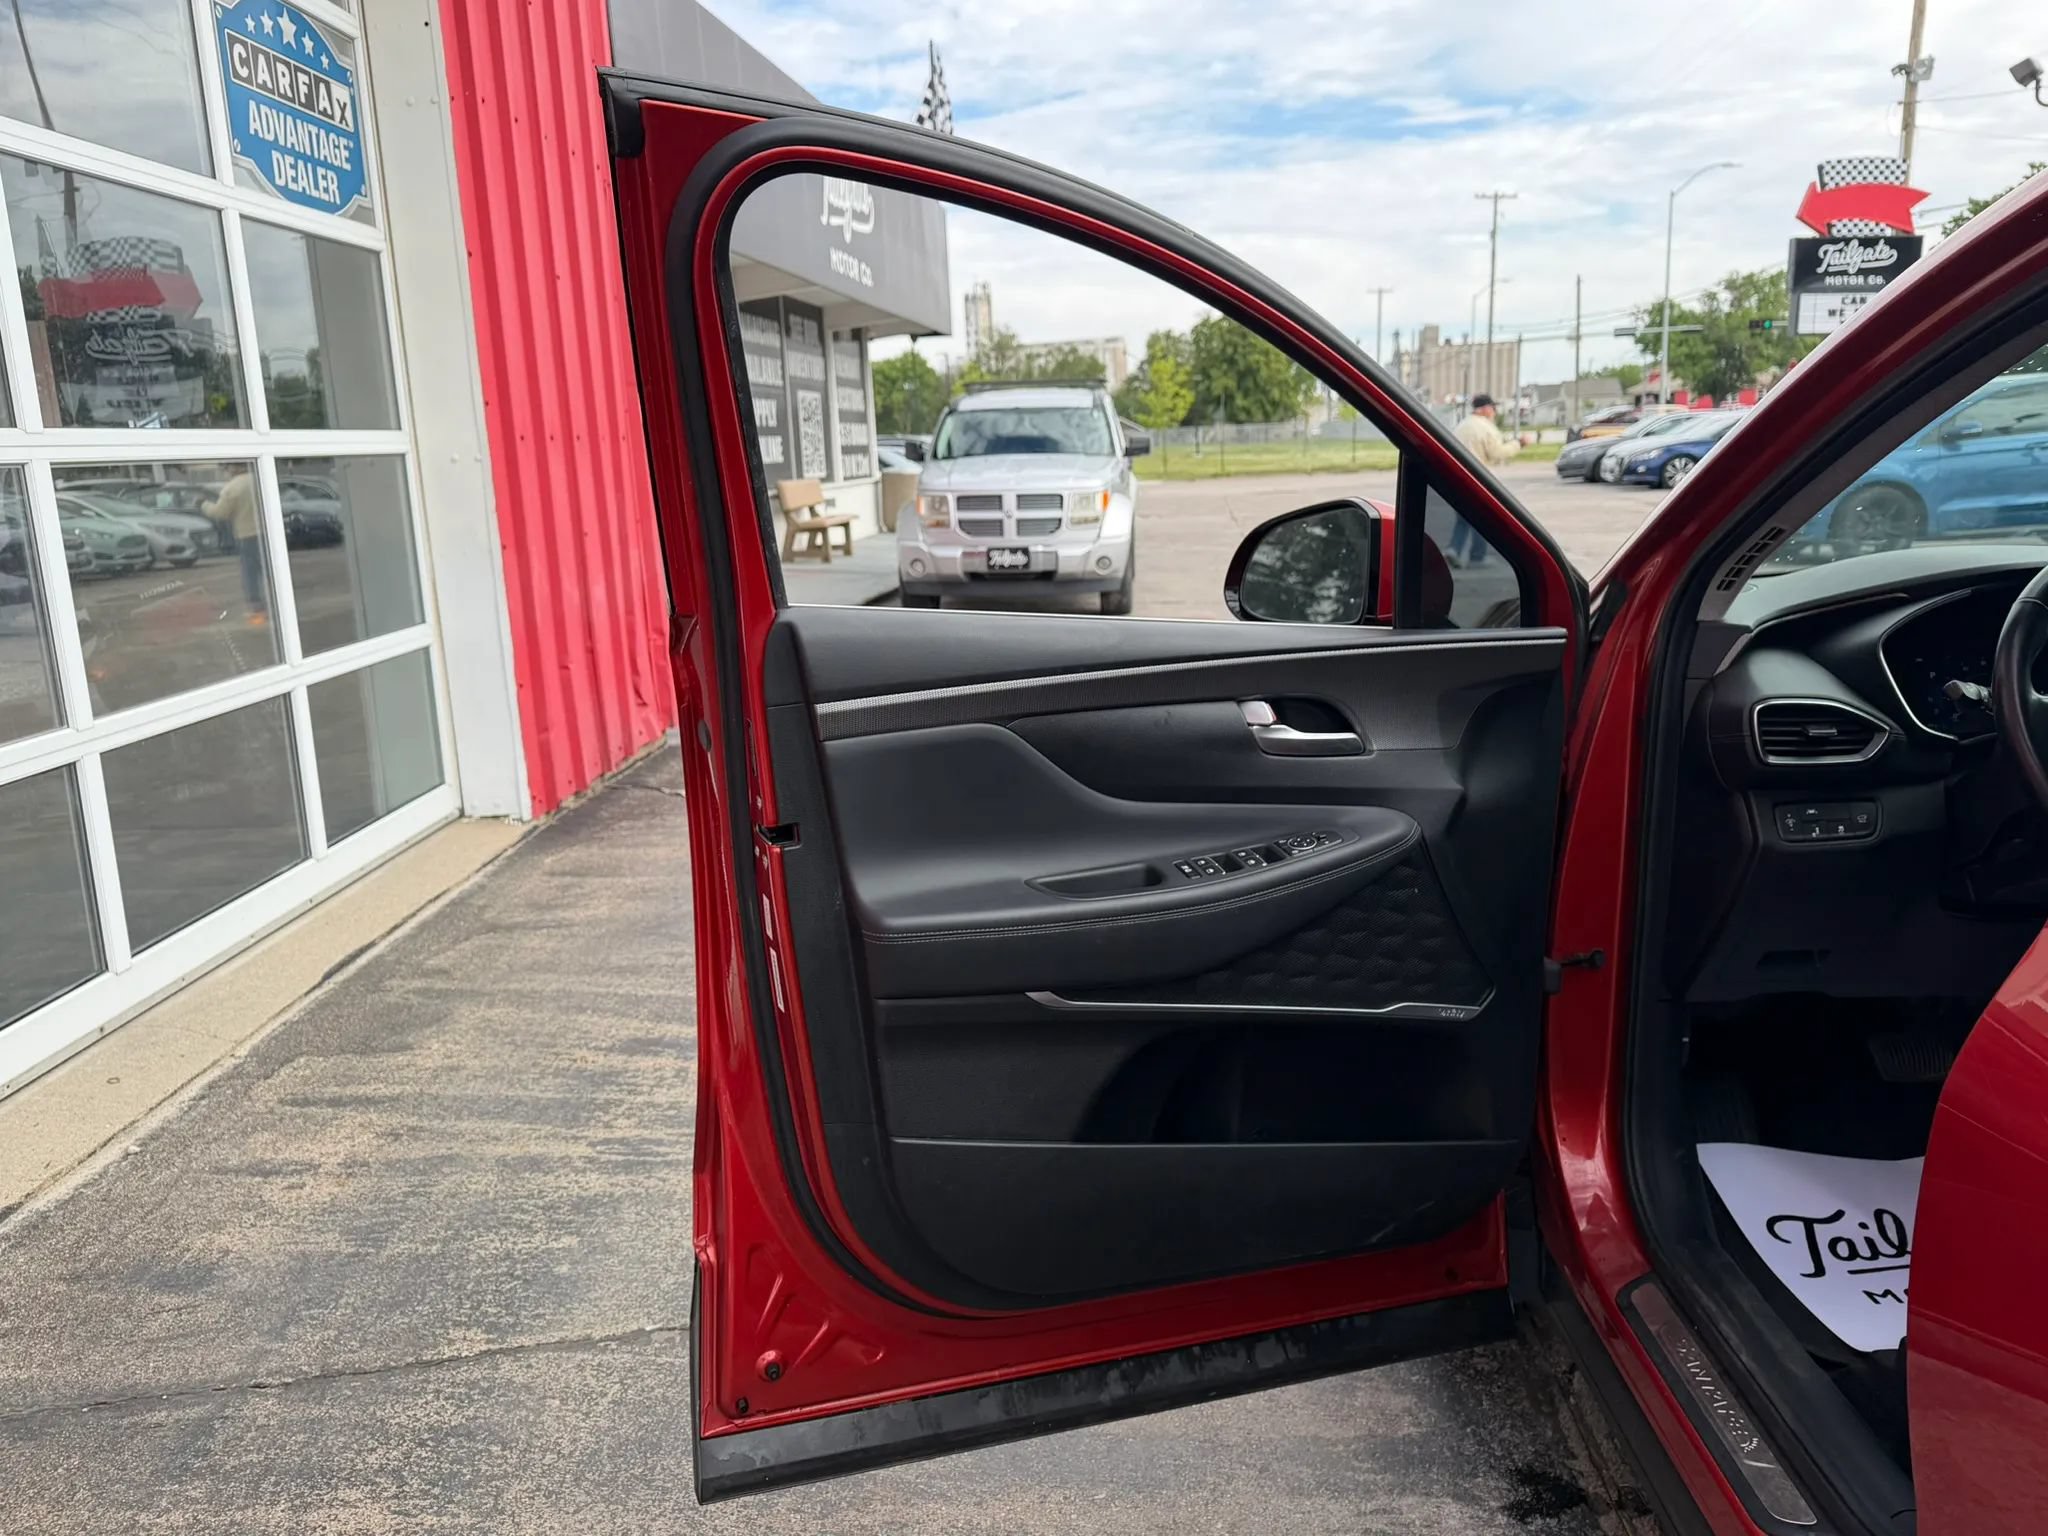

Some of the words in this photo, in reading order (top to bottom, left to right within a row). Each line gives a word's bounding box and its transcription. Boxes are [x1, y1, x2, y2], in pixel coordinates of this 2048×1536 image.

[231, 42, 350, 128] CARFAX
[249, 99, 351, 172] ADVANTAGE
[271, 149, 340, 205] DEALER
[1815, 238, 1898, 274] Tailgate
[1824, 274, 1865, 286] MOTOR
